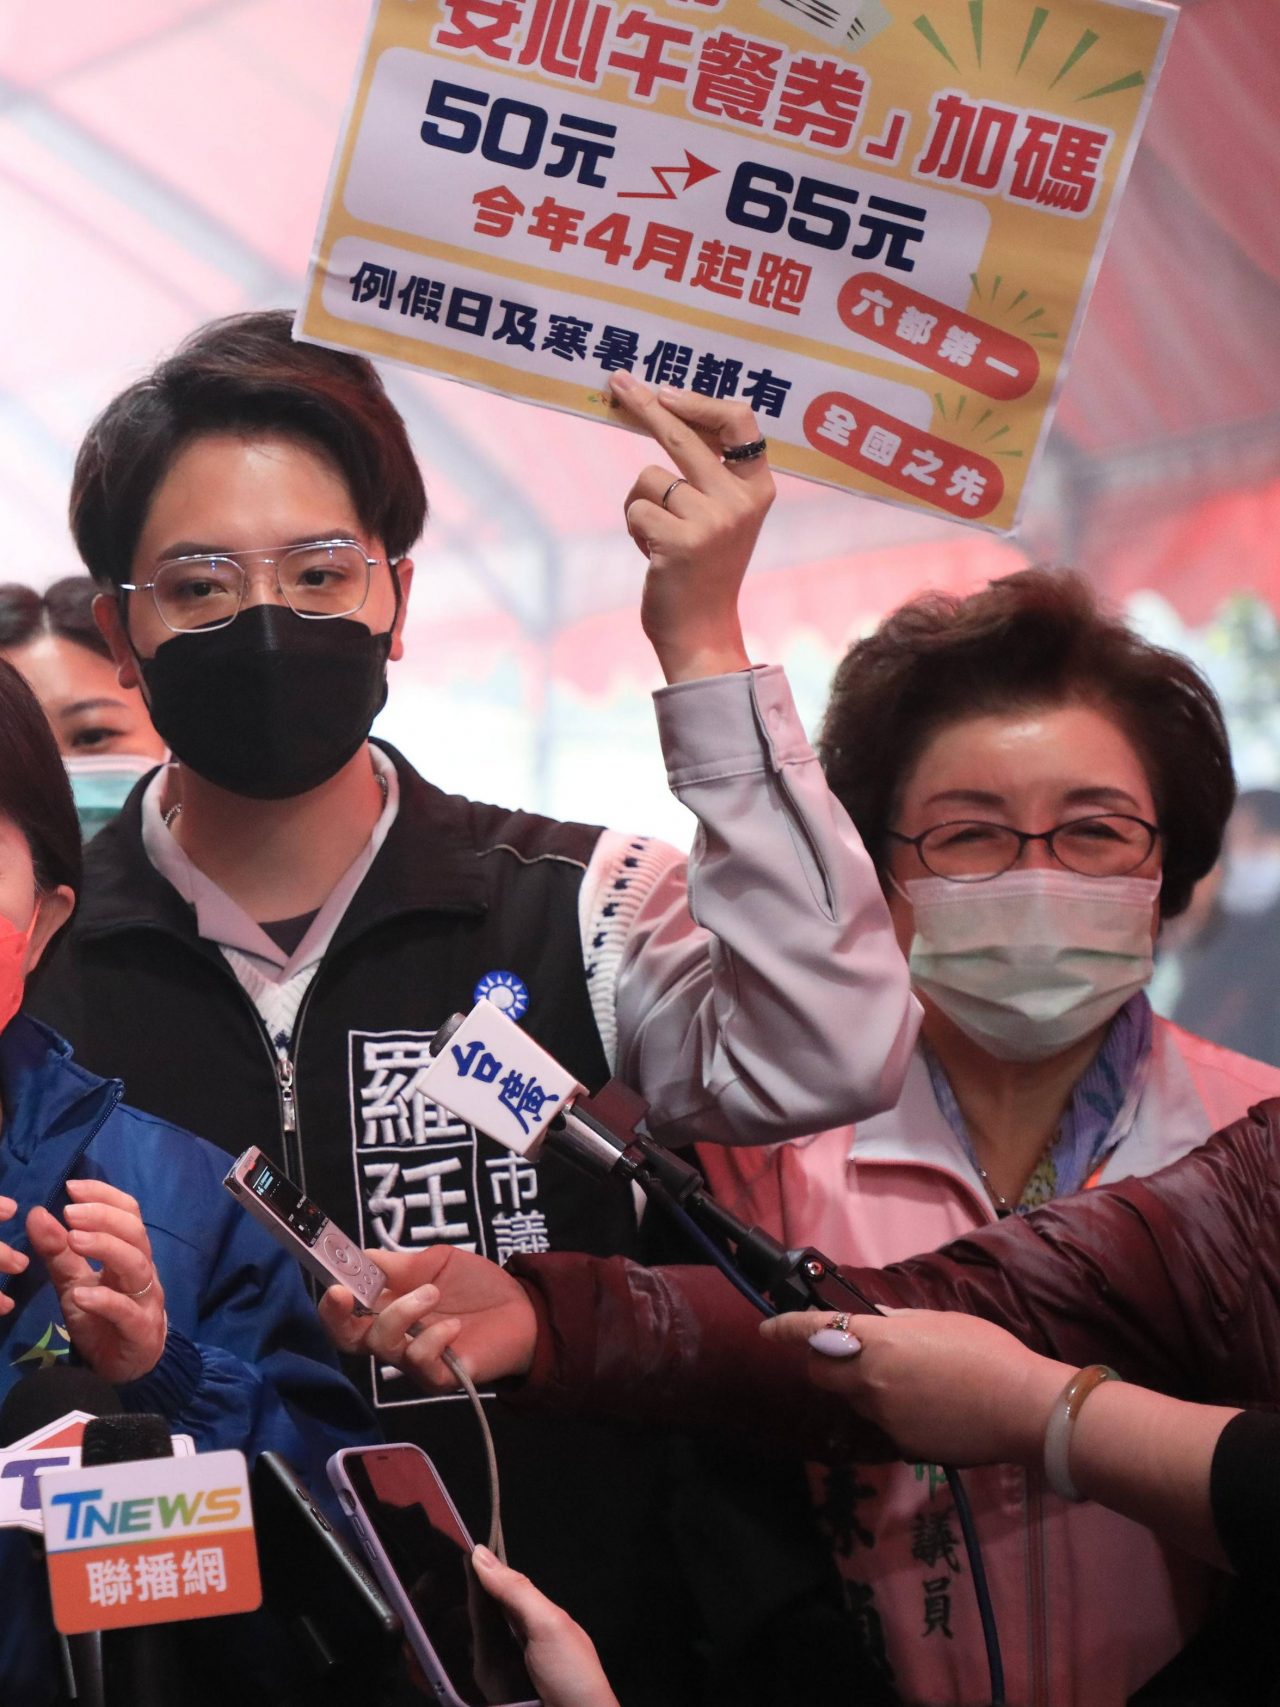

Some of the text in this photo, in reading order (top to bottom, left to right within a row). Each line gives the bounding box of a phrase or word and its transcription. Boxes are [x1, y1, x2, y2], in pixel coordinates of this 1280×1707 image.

[421, 79, 927, 273] 50元 65元
[473, 186, 812, 316] 今年4月起跑
[350, 261, 793, 419] 例假日及寒暑假都有
[851, 288, 1021, 380] 六都第一
[816, 405, 989, 508] 全國之先
[451, 1041, 560, 1135] 台廣
[51, 1487, 241, 1541] TNEWS
[86, 1547, 227, 1607] 聯播網
